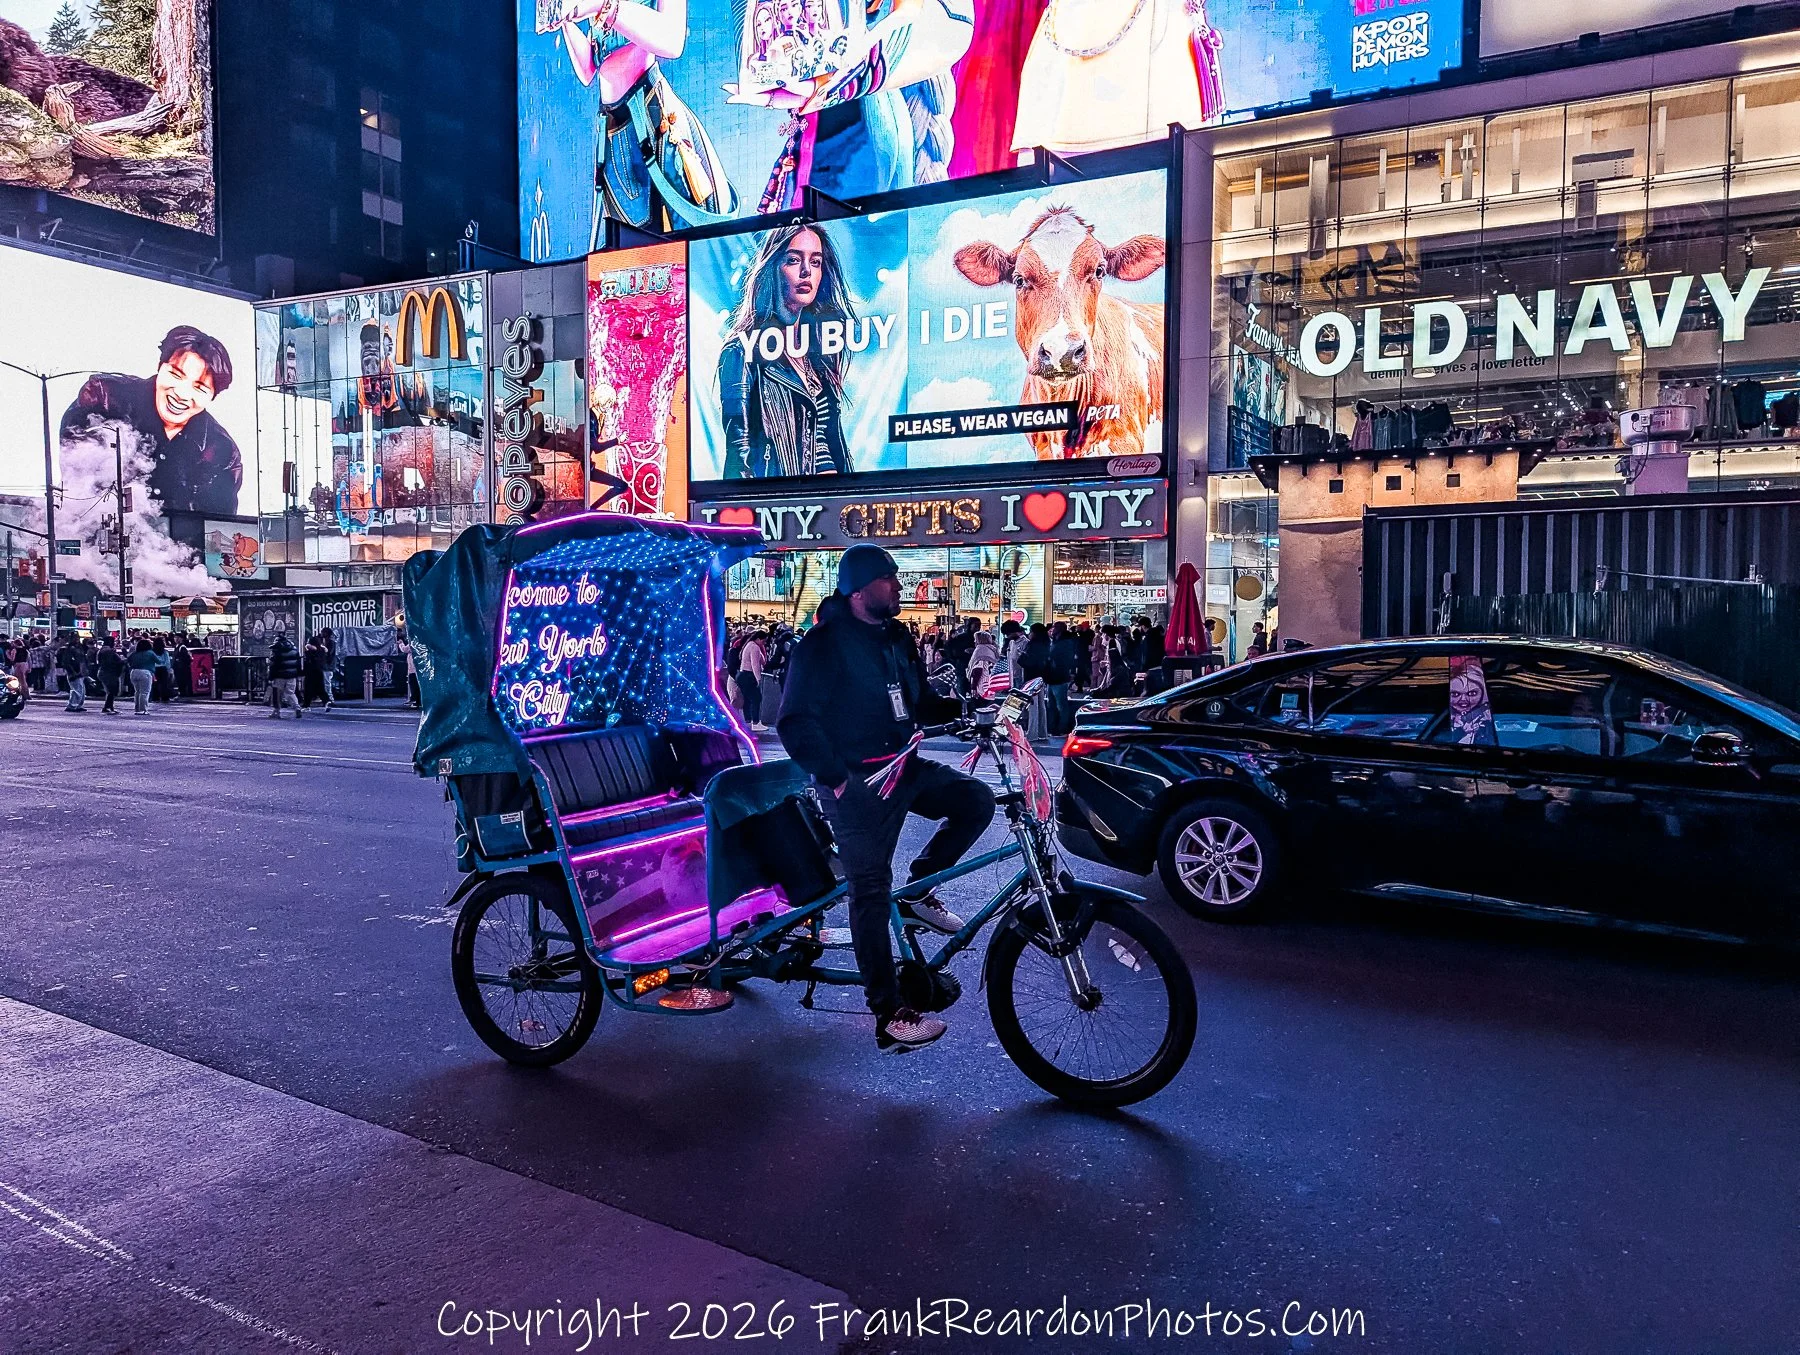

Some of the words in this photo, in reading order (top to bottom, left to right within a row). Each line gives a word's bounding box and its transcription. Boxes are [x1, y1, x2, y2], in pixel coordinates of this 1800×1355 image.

[1353, 24, 1428, 56] DEMON
[1352, 43, 1430, 72] HUNTERS
[739, 324, 810, 363] YOU
[821, 314, 897, 356] BUY
[920, 310, 930, 345] I
[944, 301, 1009, 343] DIE
[1299, 300, 1468, 378] OLD
[1495, 267, 1771, 361] NAVY
[1470, 362, 1478, 371] a
[1482, 358, 1507, 371] love
[1511, 357, 1547, 369] letter
[894, 418, 956, 436] PLEASE,
[960, 413, 1008, 432] WEAR
[1012, 408, 1069, 427] VEGAN
[1112, 457, 1158, 473] Heritage
[839, 498, 982, 538] GIFTS
[1001, 494, 1021, 532] I
[576, 572, 600, 604] to
[137, 608, 160, 618] MART
[312, 599, 376, 615] DISCOVER
[500, 637, 529, 665] ew
[539, 623, 607, 674] York
[510, 679, 570, 726] City
